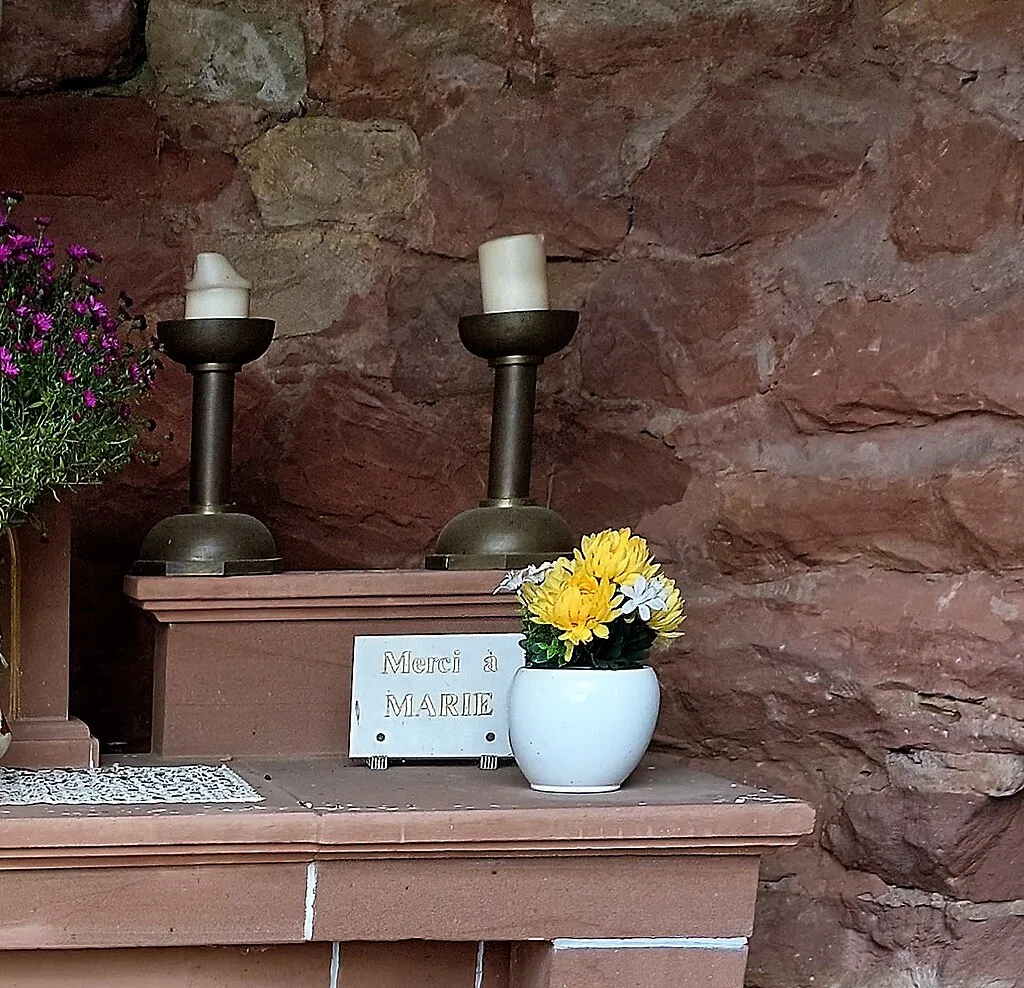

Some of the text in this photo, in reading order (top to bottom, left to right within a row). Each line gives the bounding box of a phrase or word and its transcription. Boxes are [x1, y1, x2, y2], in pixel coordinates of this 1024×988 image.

[381, 649, 499, 675] Merci à
[384, 692, 494, 718] MARIE
